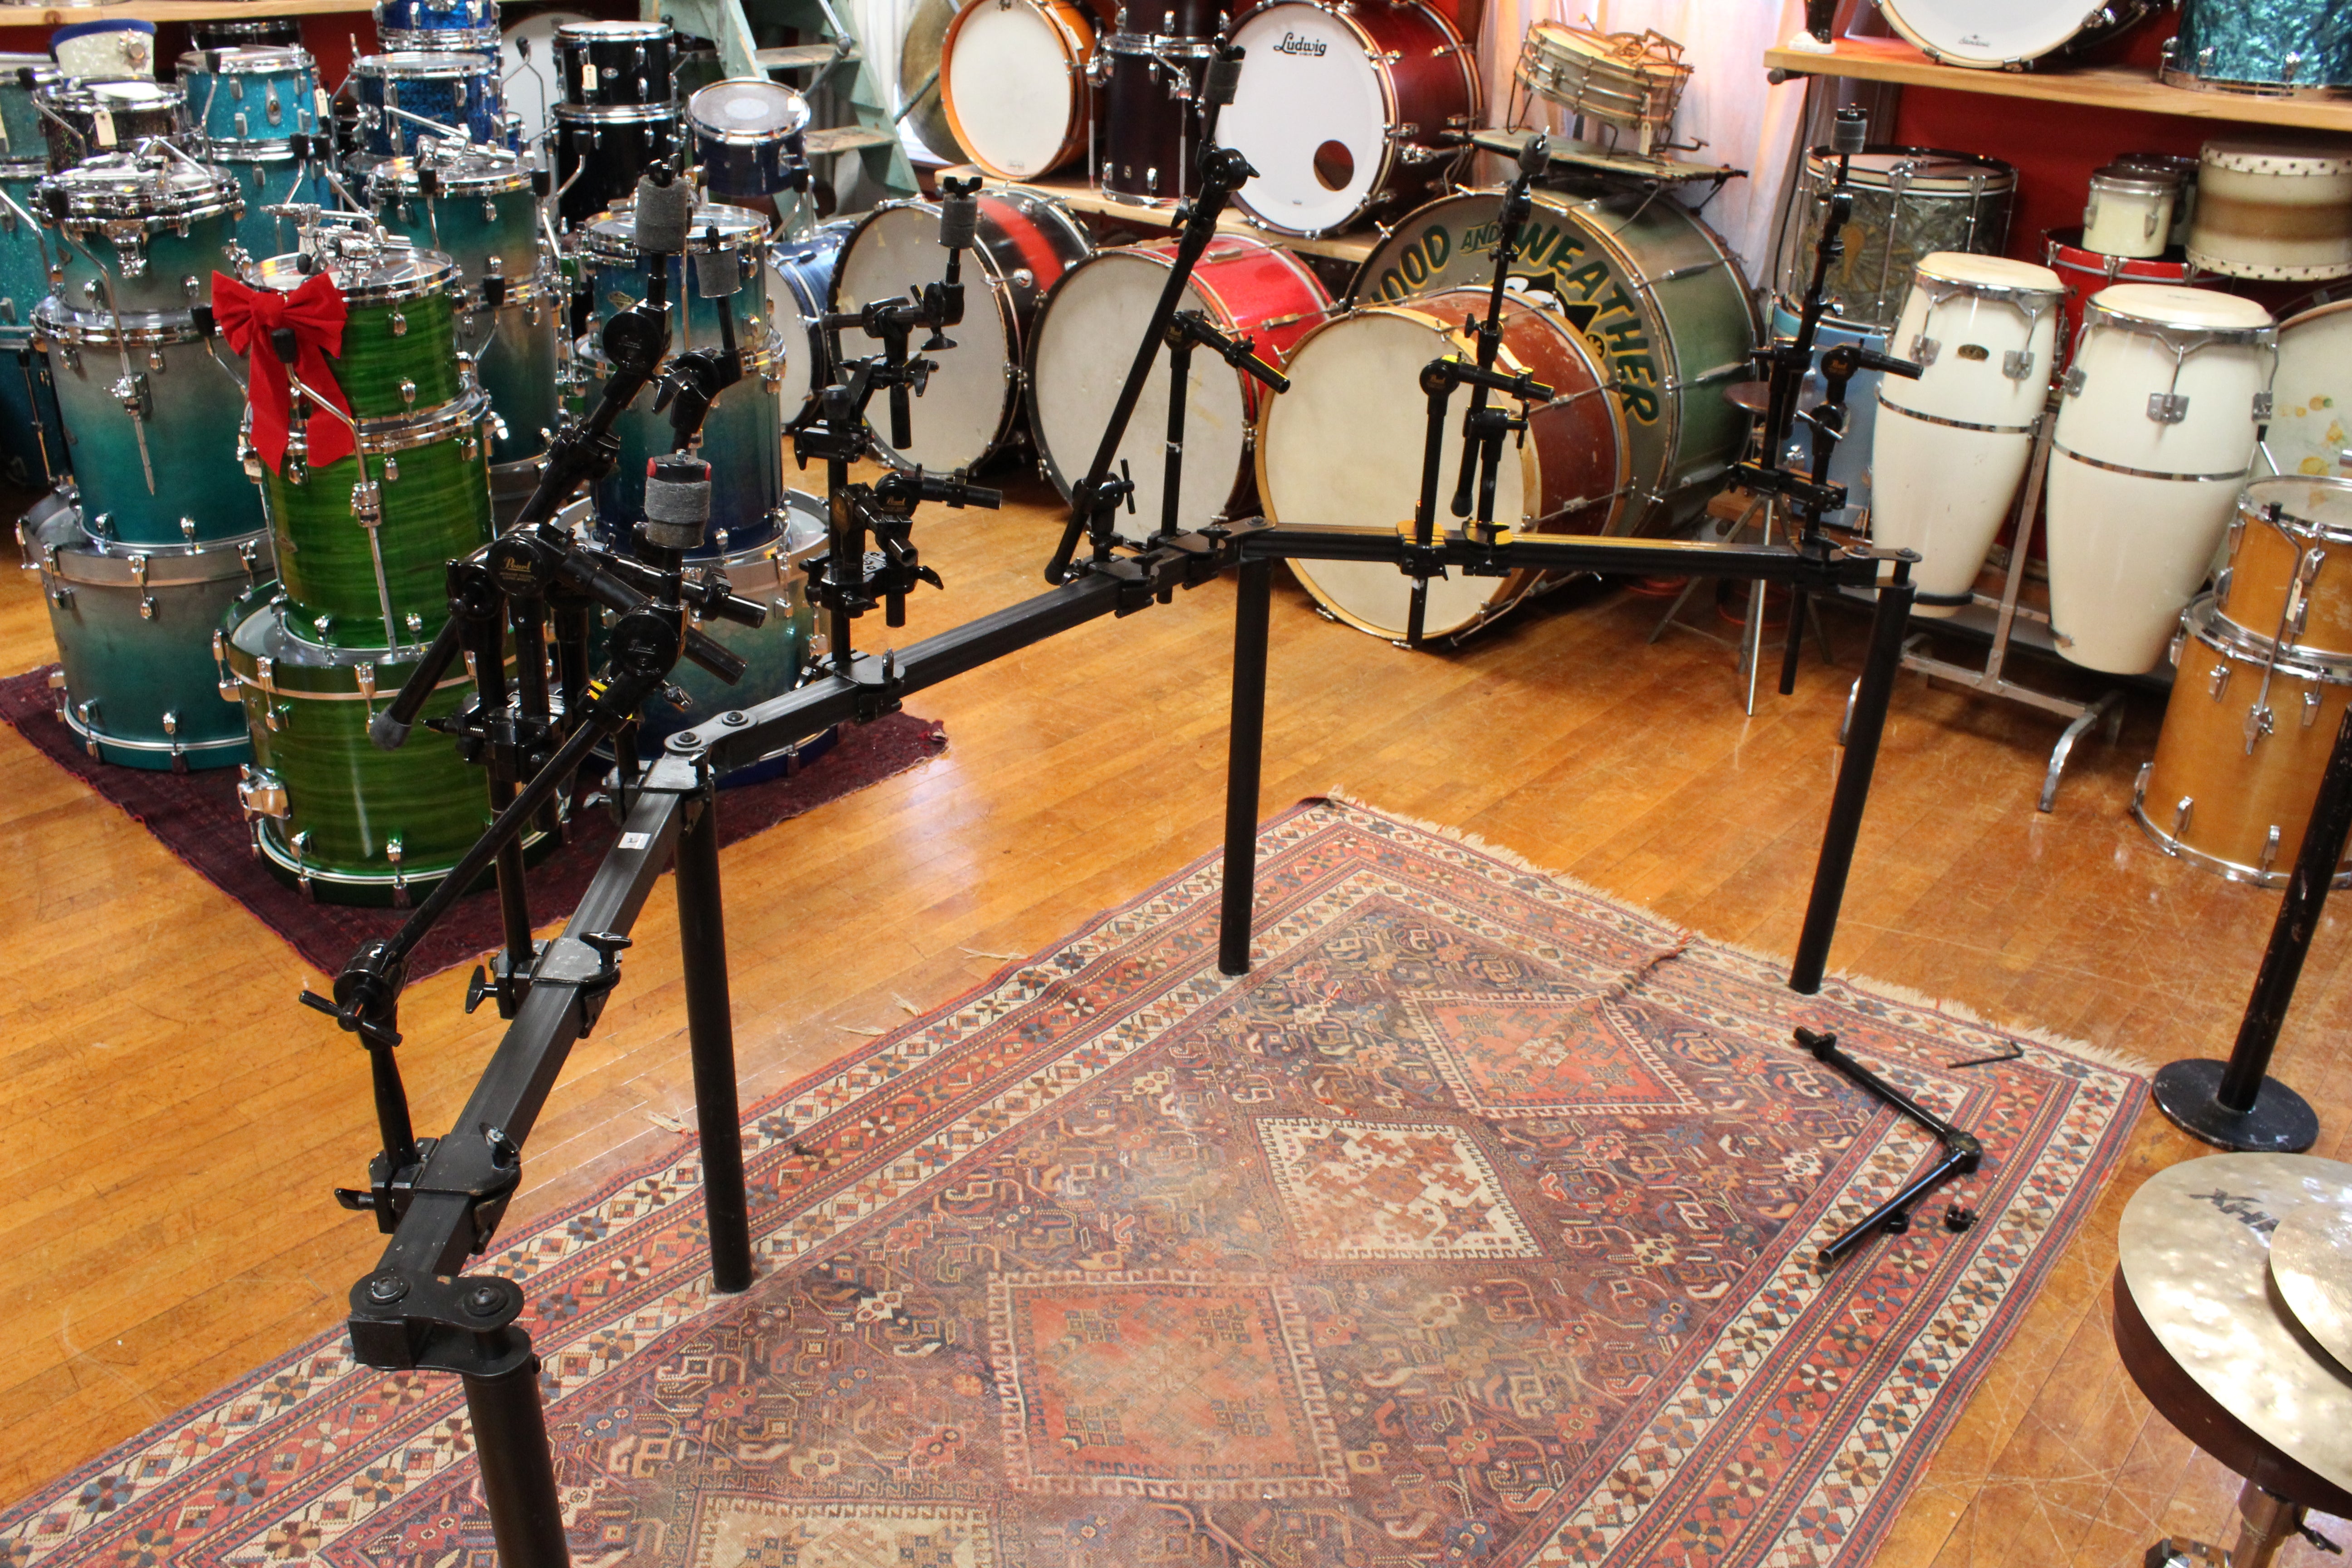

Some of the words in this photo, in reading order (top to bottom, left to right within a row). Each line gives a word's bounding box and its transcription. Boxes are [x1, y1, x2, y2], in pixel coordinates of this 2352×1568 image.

[1273, 31, 1327, 56] Ludwig
[1369, 224, 1451, 307] OOD
[1459, 220, 1504, 255] AND
[1515, 222, 1659, 426] WEATHER
